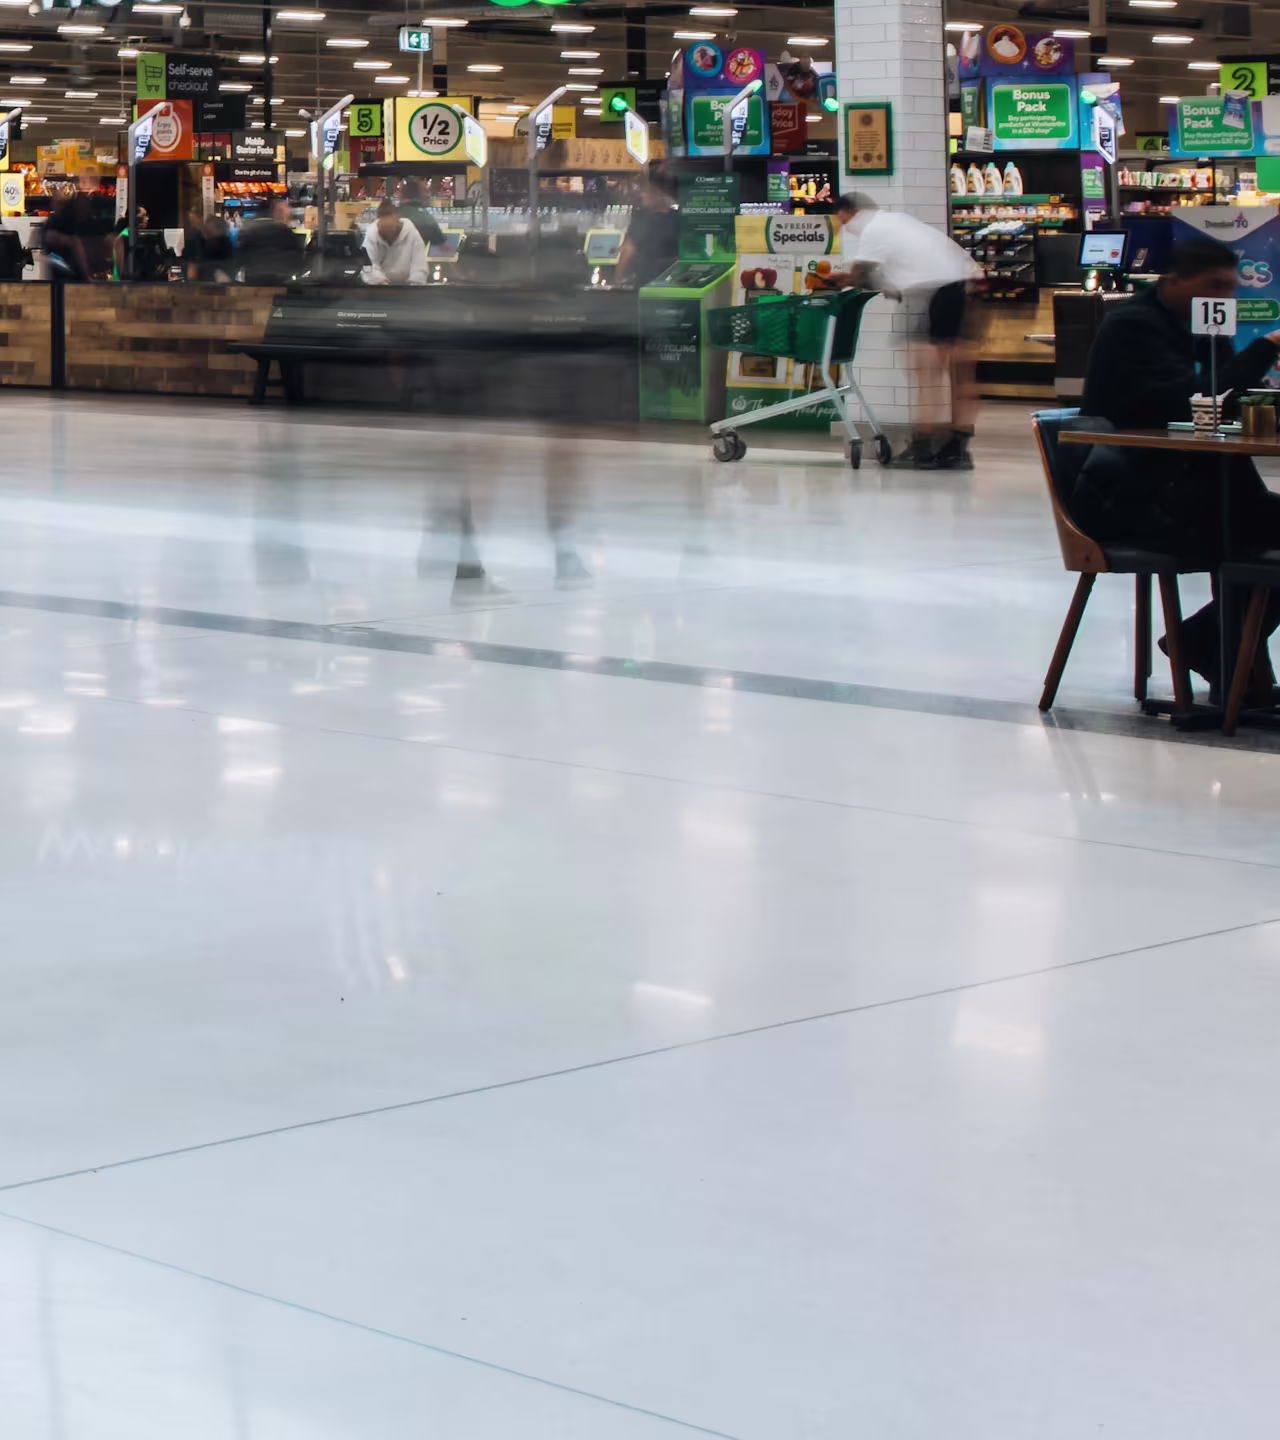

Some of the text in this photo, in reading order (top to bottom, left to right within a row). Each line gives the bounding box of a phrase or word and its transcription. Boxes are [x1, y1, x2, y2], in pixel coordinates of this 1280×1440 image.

[168, 63, 214, 77] Self-serve
[168, 80, 209, 92] checkout
[1231, 67, 1256, 97] 2
[1013, 89, 1050, 101] Bonus
[1017, 100, 1047, 112] Pack
[1182, 104, 1221, 116] Bonus
[357, 108, 373, 133] 5
[420, 113, 450, 136] 1/2
[1183, 117, 1214, 129] Pack
[422, 136, 449, 146] Price
[773, 230, 825, 245] Specials
[1201, 301, 1226, 326] 15
